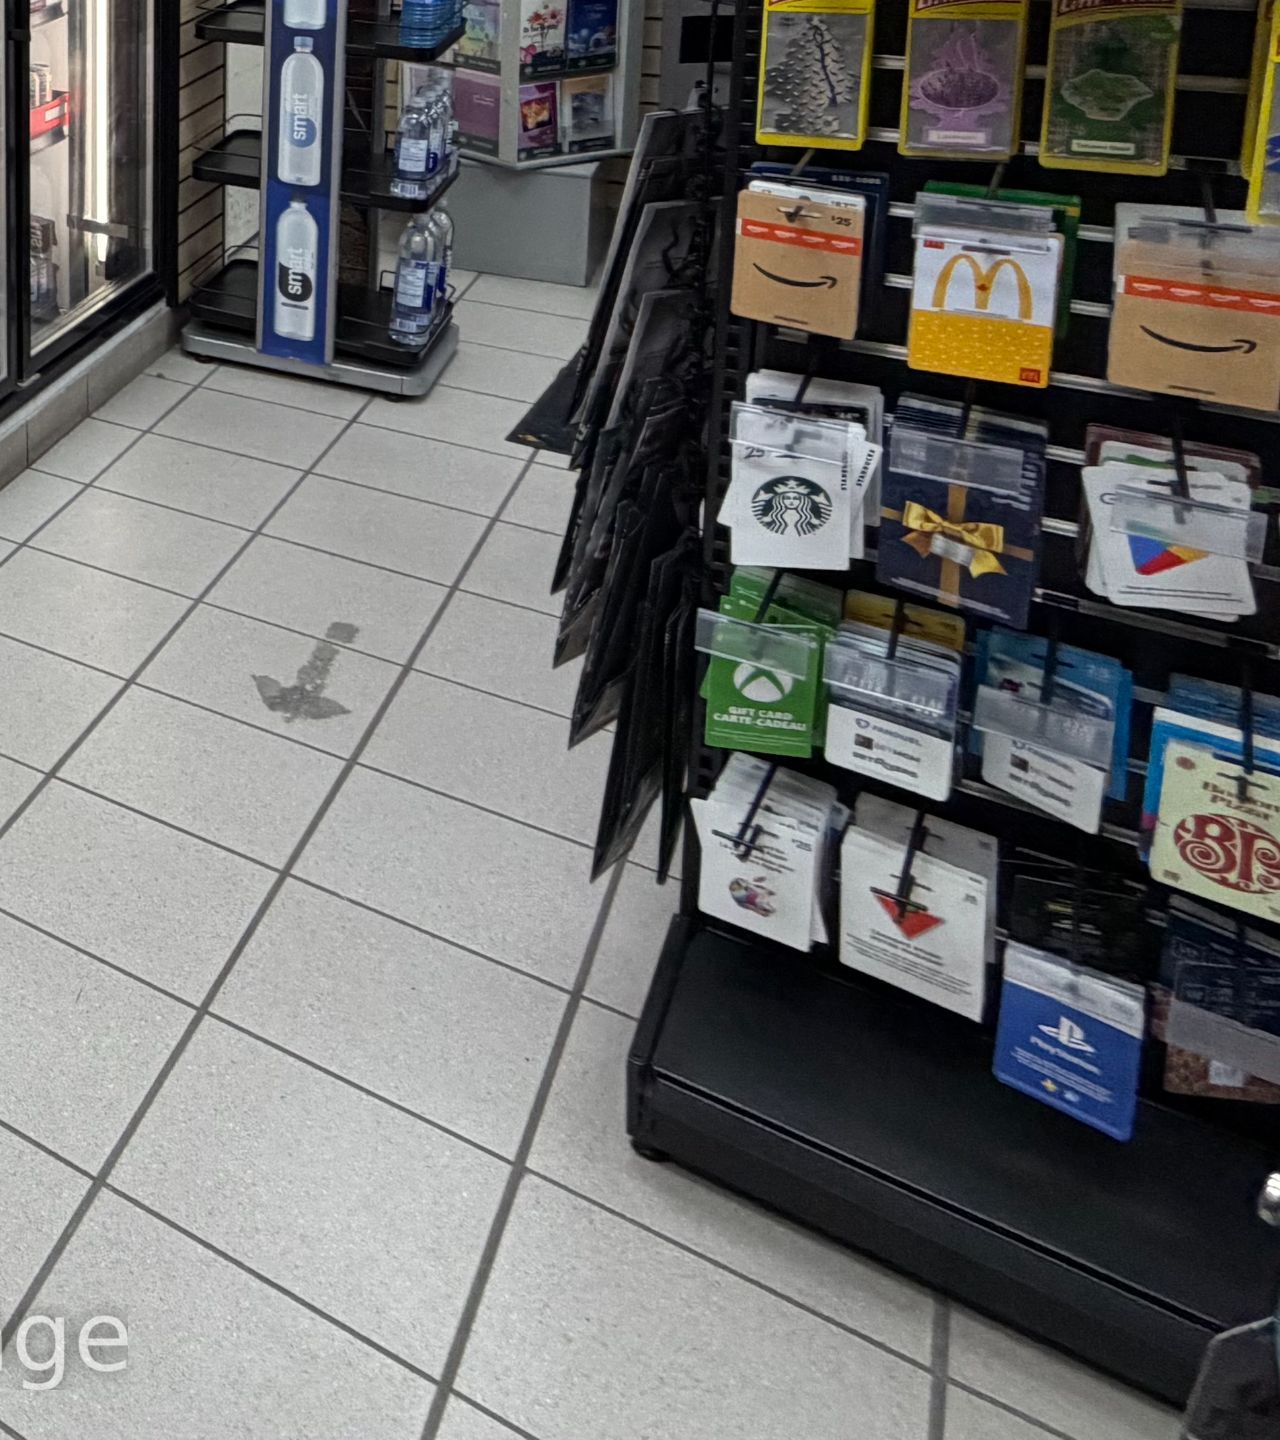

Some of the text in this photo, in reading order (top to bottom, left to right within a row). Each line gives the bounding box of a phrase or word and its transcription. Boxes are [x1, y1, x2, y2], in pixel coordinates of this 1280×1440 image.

[292, 92, 309, 142] smart
[287, 247, 304, 296] smart
[728, 706, 793, 721] GIFT CARD
